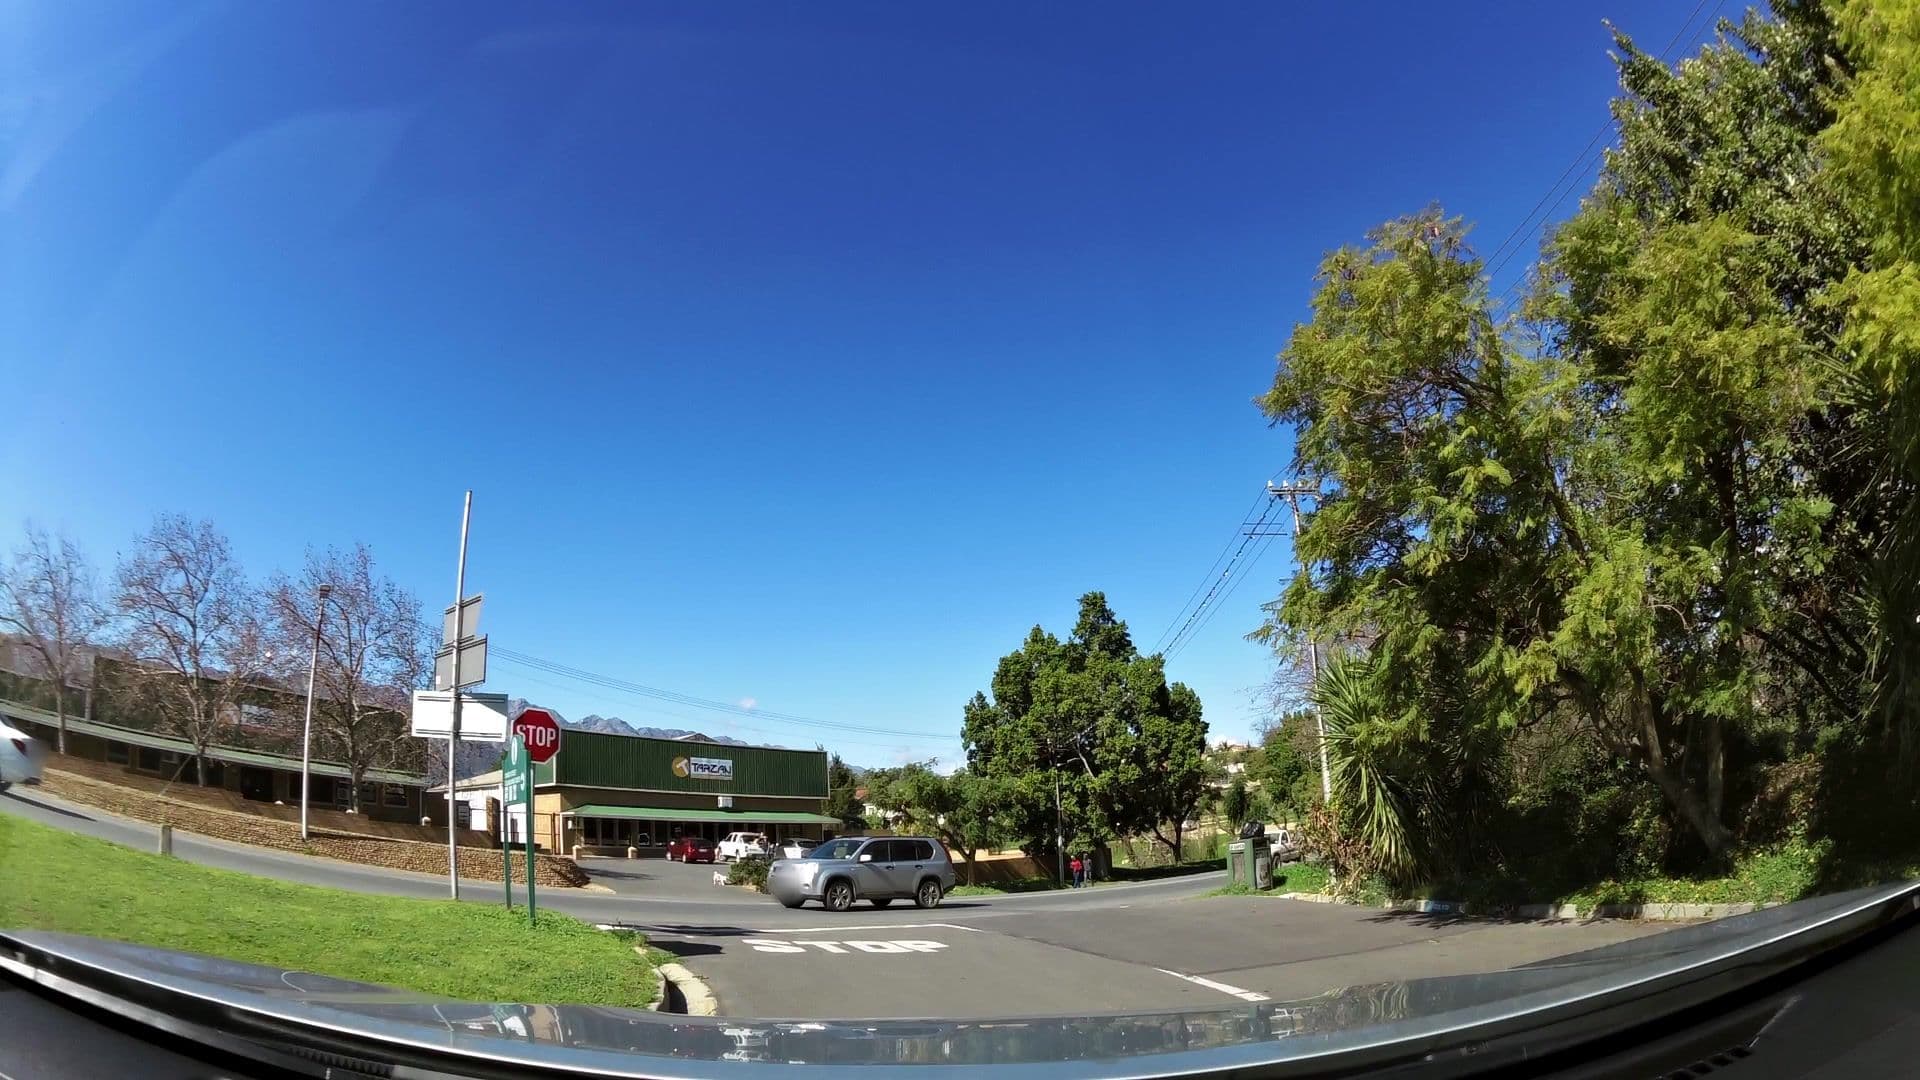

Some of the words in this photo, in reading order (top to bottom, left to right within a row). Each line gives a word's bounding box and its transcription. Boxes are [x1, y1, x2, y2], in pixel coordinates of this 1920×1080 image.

[516, 724, 556, 748] STOP
[691, 762, 732, 774] TARZAN
[741, 939, 950, 954] STOP
